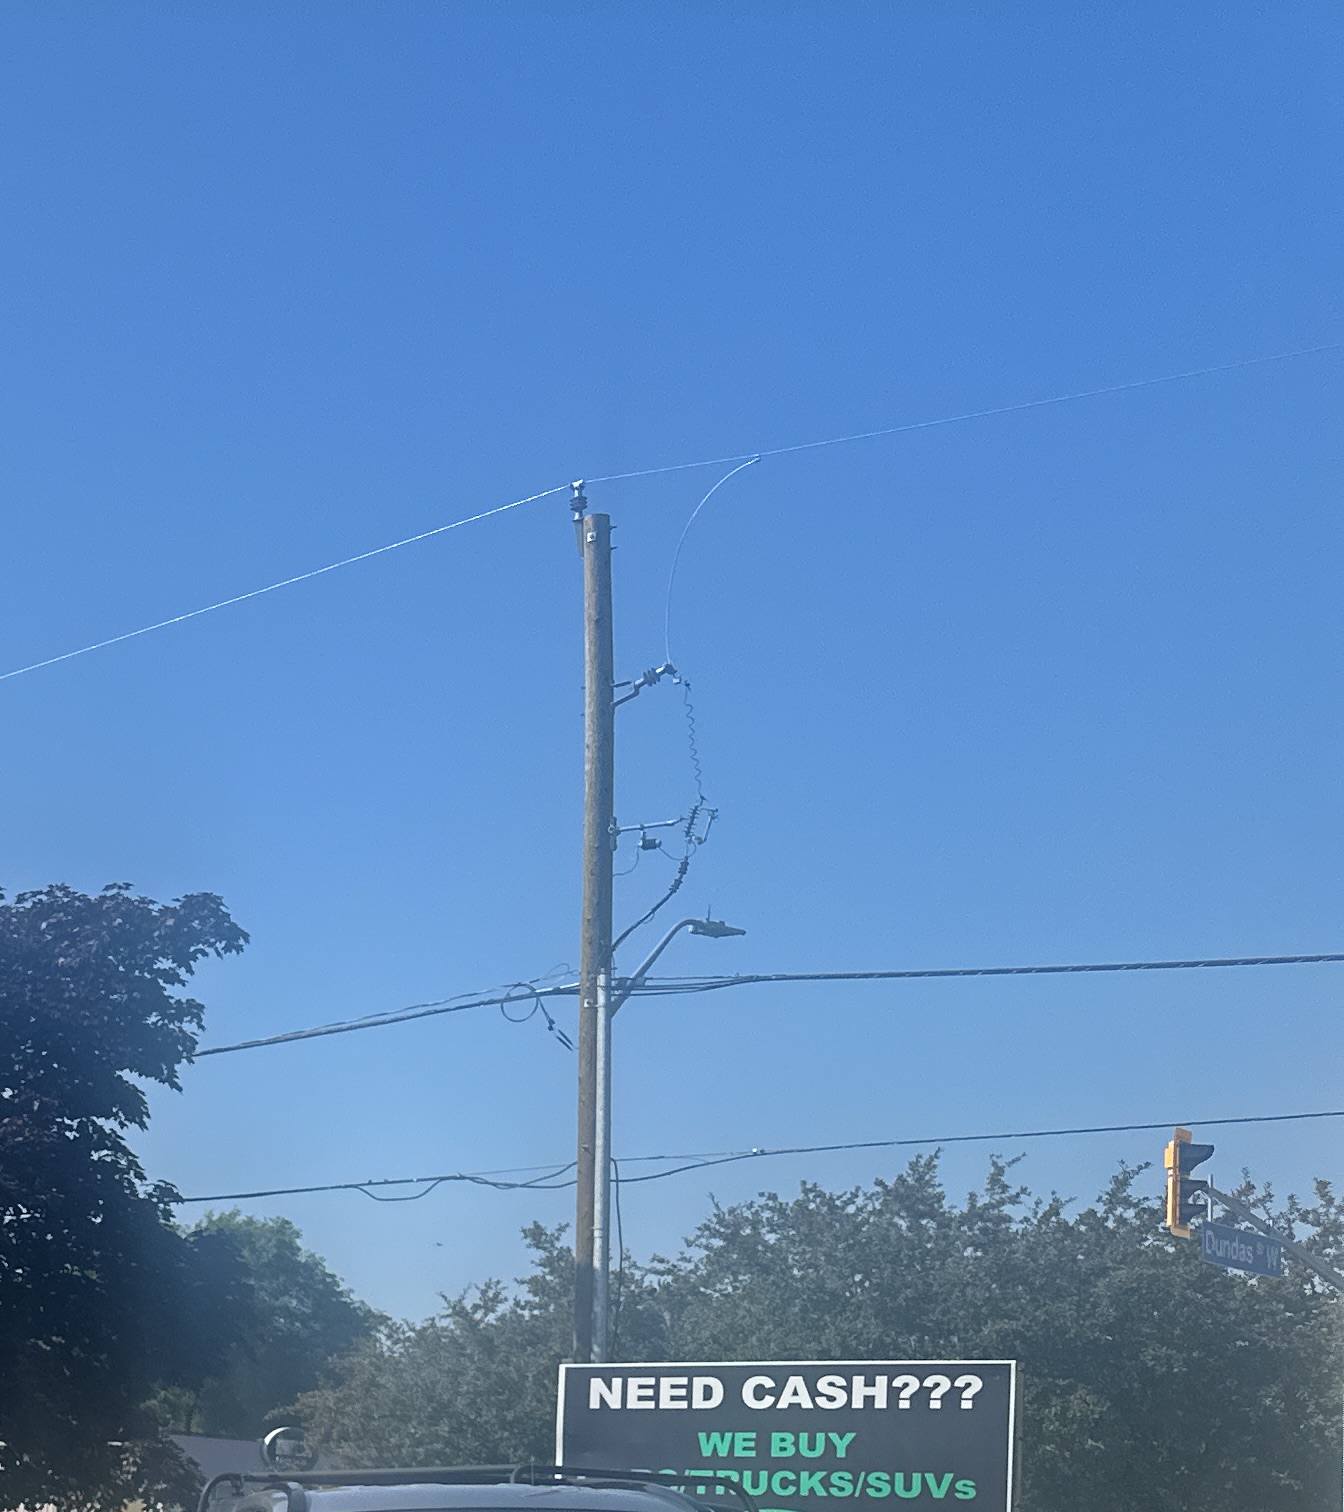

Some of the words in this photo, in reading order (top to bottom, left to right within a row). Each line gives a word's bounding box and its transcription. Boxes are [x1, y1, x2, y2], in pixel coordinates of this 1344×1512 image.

[1205, 1229, 1254, 1265] Dundas
[1266, 1244, 1280, 1271] W
[588, 1376, 725, 1410] NEED
[741, 1374, 984, 1410] CASH???
[698, 1432, 757, 1458] WE
[770, 1432, 857, 1459] BUY
